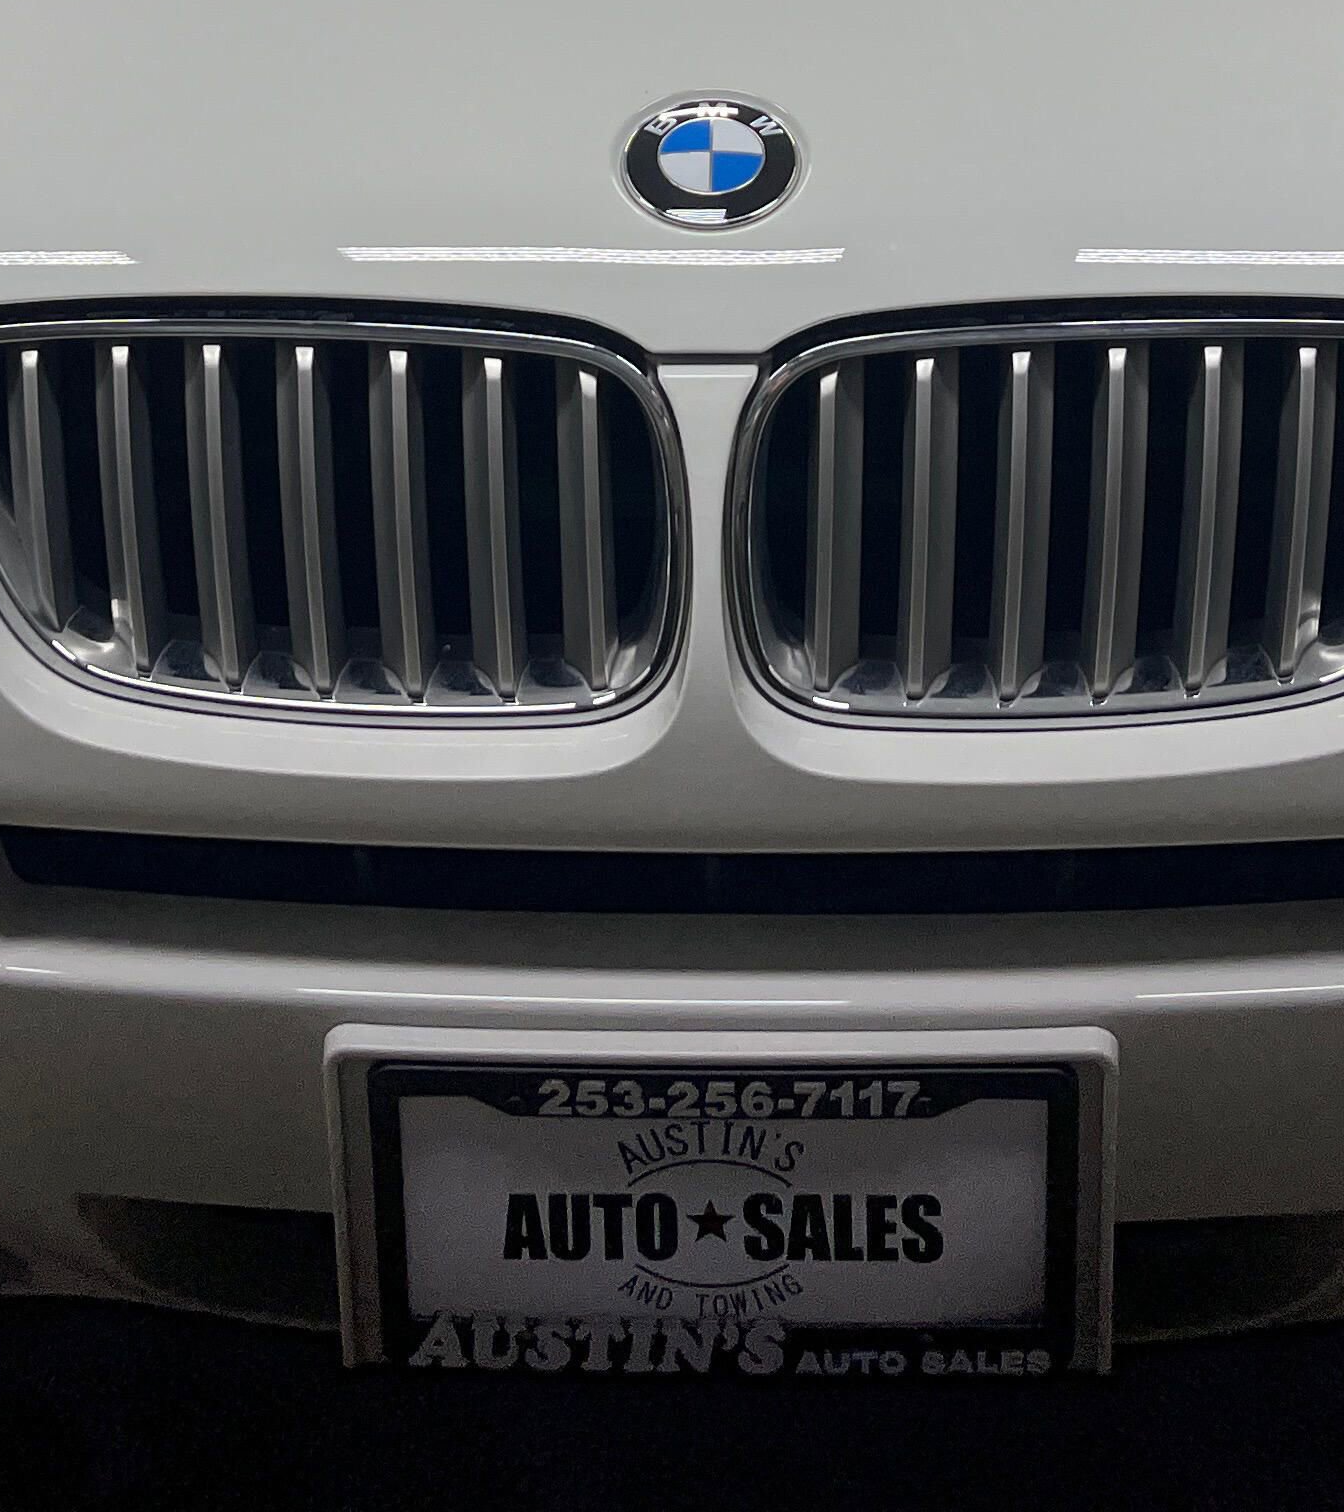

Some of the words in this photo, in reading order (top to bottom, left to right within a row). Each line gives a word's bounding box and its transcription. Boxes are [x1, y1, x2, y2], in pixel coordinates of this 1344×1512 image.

[644, 102, 784, 137] BMW
[537, 1078, 921, 1119] 253-256-7117
[617, 1118, 805, 1176] AUSTIN'S
[503, 1191, 679, 1262] AUTO
[742, 1191, 945, 1264] SALES
[618, 1272, 675, 1312] AND
[693, 1271, 805, 1320] TOWING
[408, 1311, 790, 1377] AUSTIN'S
[796, 1349, 906, 1377] AUTO
[922, 1347, 1052, 1377] SALES
